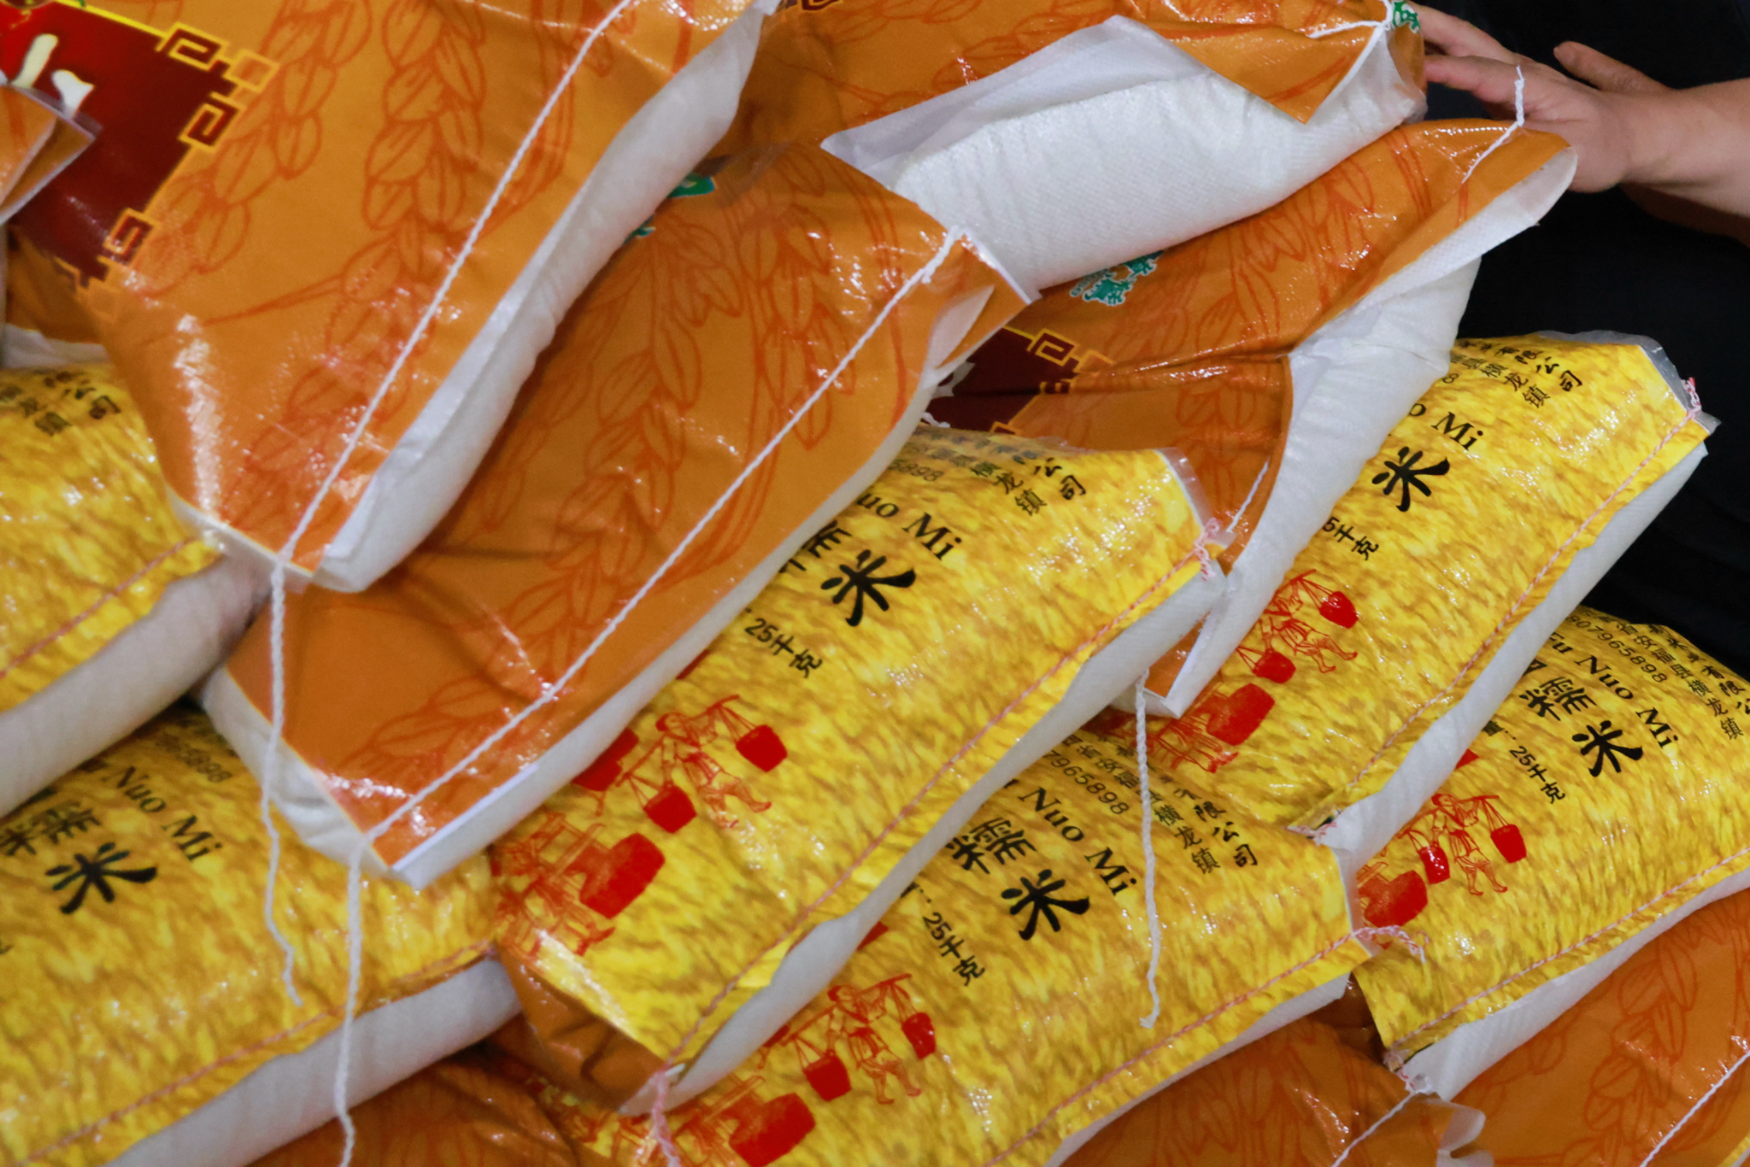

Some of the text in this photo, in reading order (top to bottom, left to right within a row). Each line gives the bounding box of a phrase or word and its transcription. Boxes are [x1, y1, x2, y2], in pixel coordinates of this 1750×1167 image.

[1431, 411, 1483, 451] Mi
[902, 512, 963, 560] Mi
[744, 618, 823, 679] 25千克
[1519, 661, 1643, 777] 糯米
[1575, 655, 1634, 700] Nuo
[1636, 707, 1679, 749] Mi
[101, 765, 223, 862] Nuo Mi
[1018, 786, 1138, 896] Nuo Mi
[945, 817, 1090, 941] 糯米
[922, 912, 986, 987] 25千克
